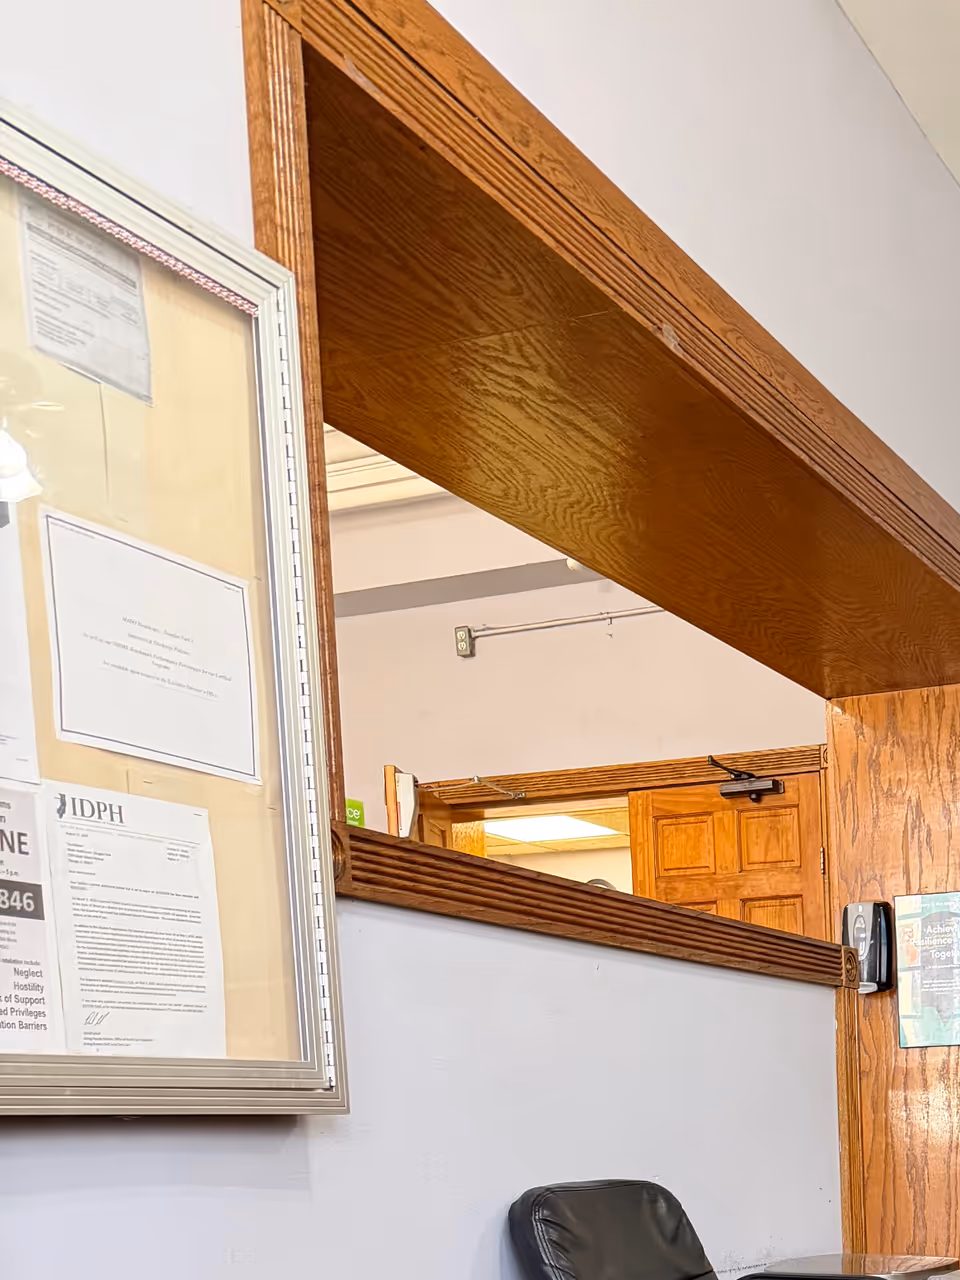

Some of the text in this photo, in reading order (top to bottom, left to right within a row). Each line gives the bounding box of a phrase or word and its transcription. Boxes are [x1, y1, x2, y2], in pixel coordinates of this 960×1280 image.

[71, 797, 124, 824] IDPH
[0, 829, 29, 856] NE
[0, 888, 35, 912] 846
[13, 966, 43, 979] Neglect
[13, 981, 45, 994] Hostility
[4, 994, 46, 1006] of Support
[10, 1007, 47, 1019] Privileges
[18, 1020, 48, 1031] Barriers
